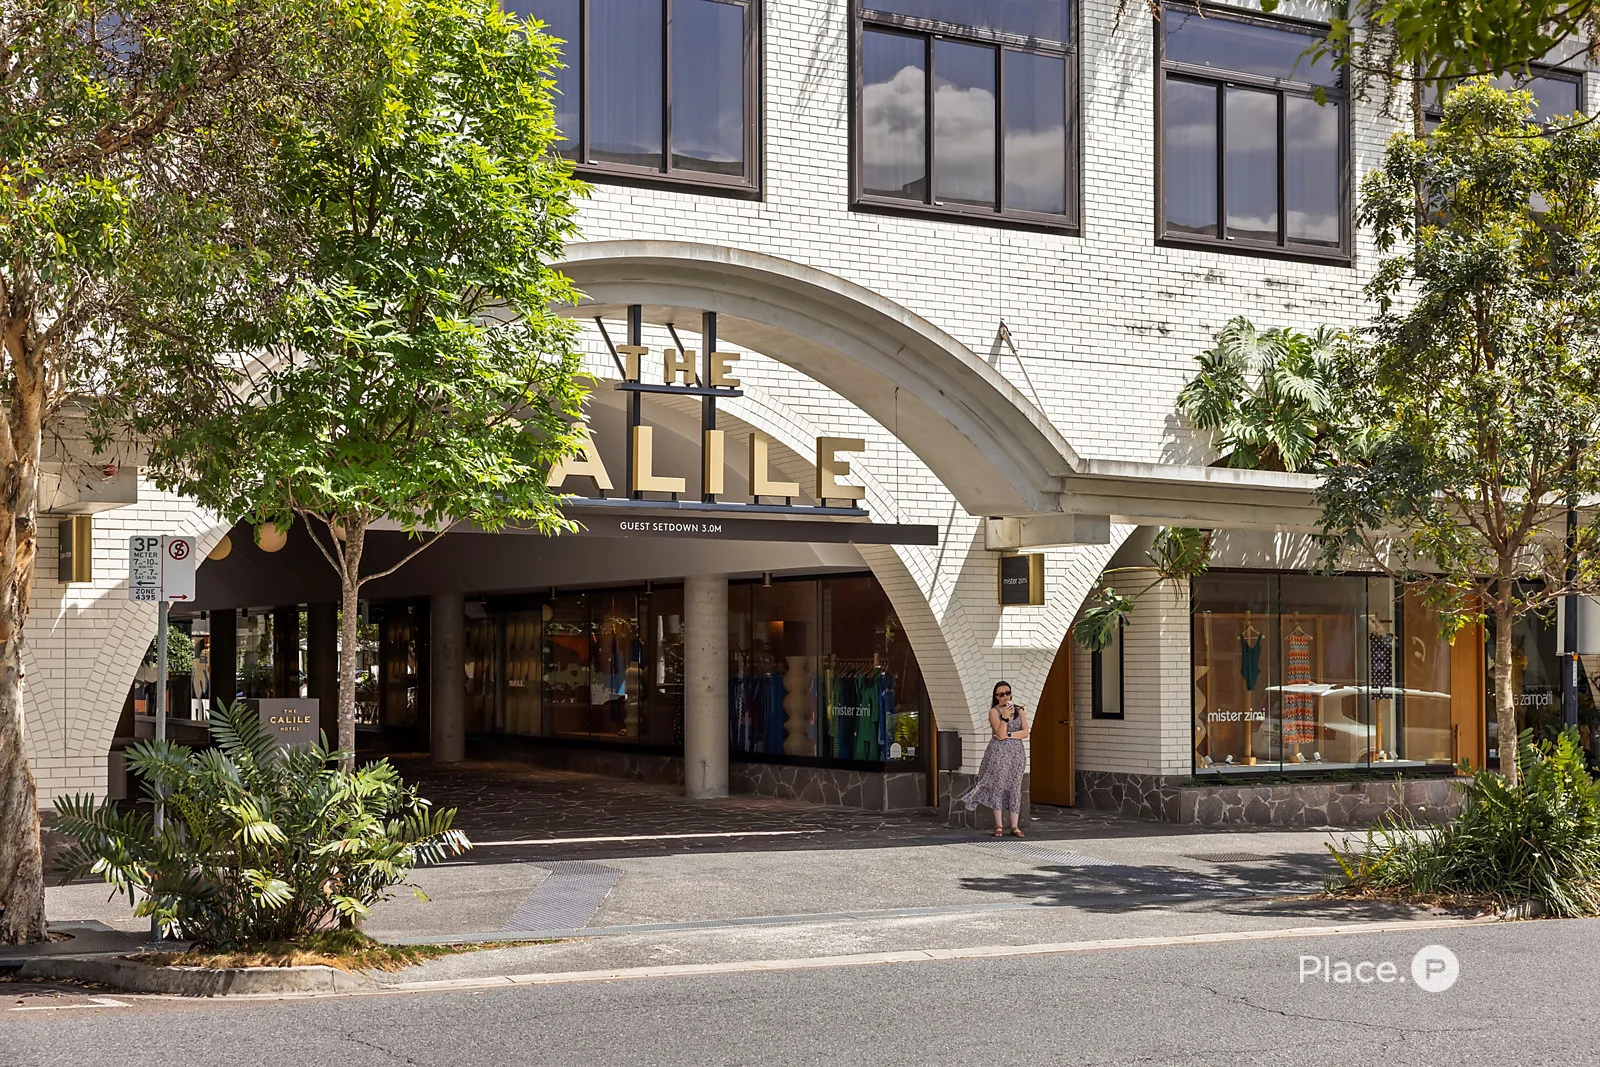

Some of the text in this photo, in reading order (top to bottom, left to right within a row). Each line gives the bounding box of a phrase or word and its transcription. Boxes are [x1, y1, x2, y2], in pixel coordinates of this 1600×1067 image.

[616, 344, 741, 388] THE
[484, 414, 866, 500] ALILE
[619, 521, 722, 533] GUEST SETDOWN 3.0M
[133, 537, 159, 552] 3P
[832, 703, 870, 717] mister zimi
[1207, 707, 1266, 722] mister zimi
[270, 716, 311, 724] CALILE
